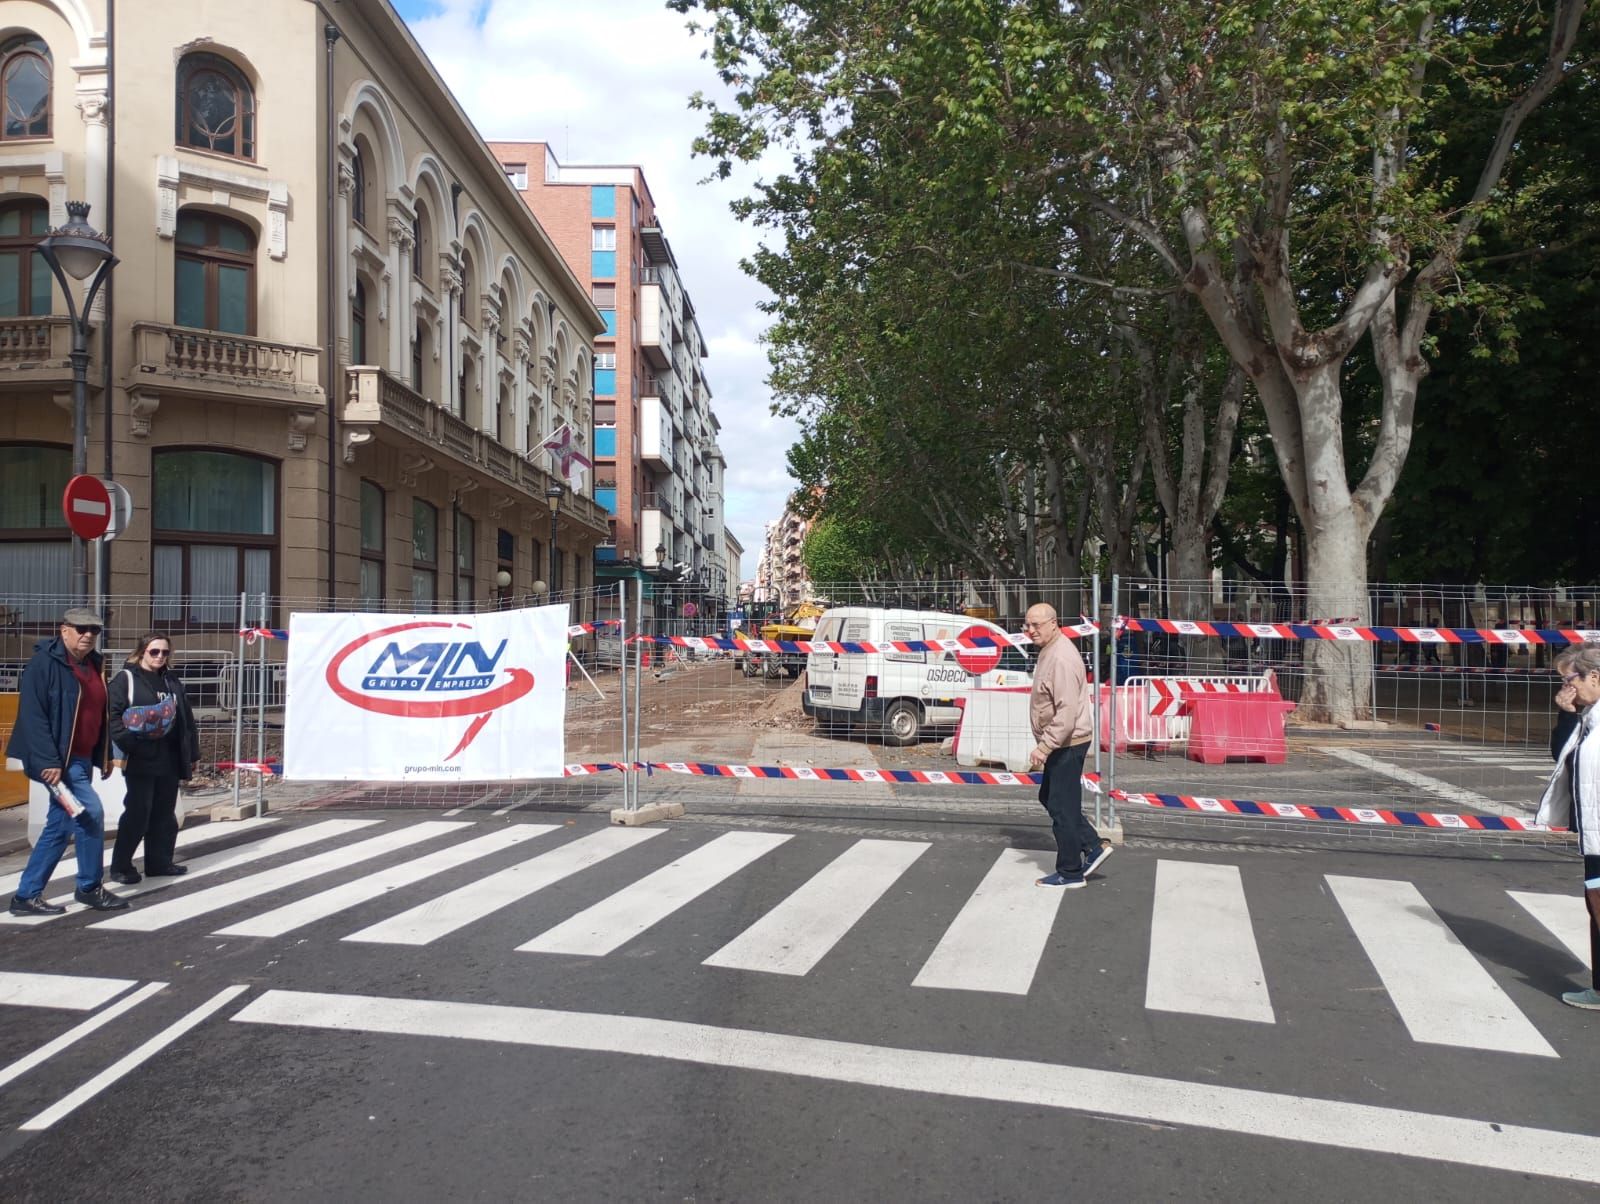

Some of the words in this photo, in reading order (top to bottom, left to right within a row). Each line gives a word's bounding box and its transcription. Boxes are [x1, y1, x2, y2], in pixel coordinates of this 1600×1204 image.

[927, 665, 967, 683] asbeca
[368, 679, 419, 688] GRUPO
[434, 678, 491, 688] EMPRESAS
